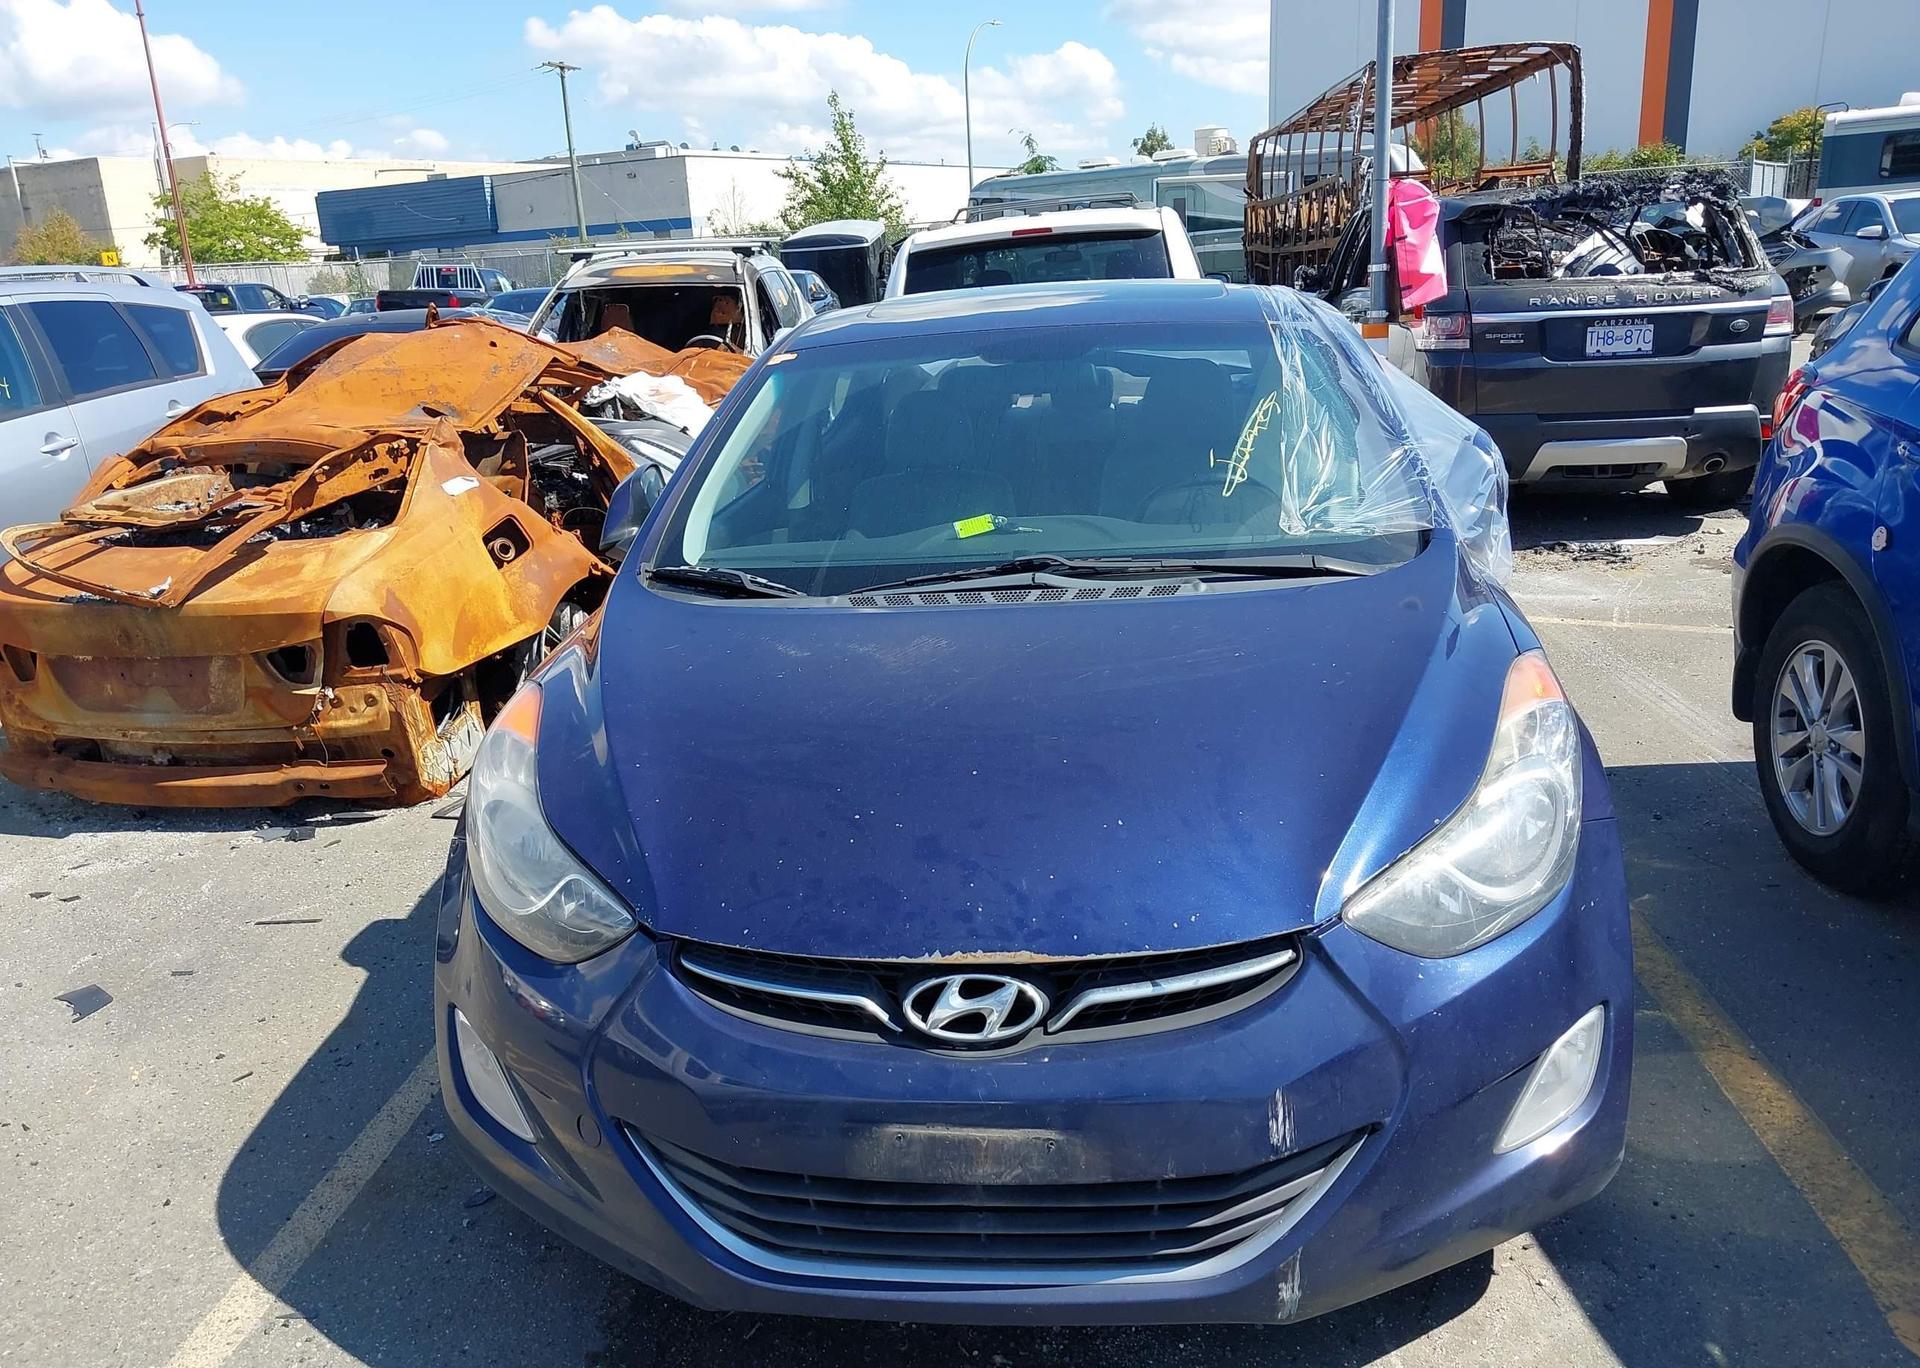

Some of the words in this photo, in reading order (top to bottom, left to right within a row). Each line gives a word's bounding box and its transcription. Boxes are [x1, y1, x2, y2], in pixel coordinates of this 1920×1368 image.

[1528, 294, 1618, 307] RANGE
[1635, 289, 1722, 302] ROVER
[1594, 317, 1649, 328] CARZONE
